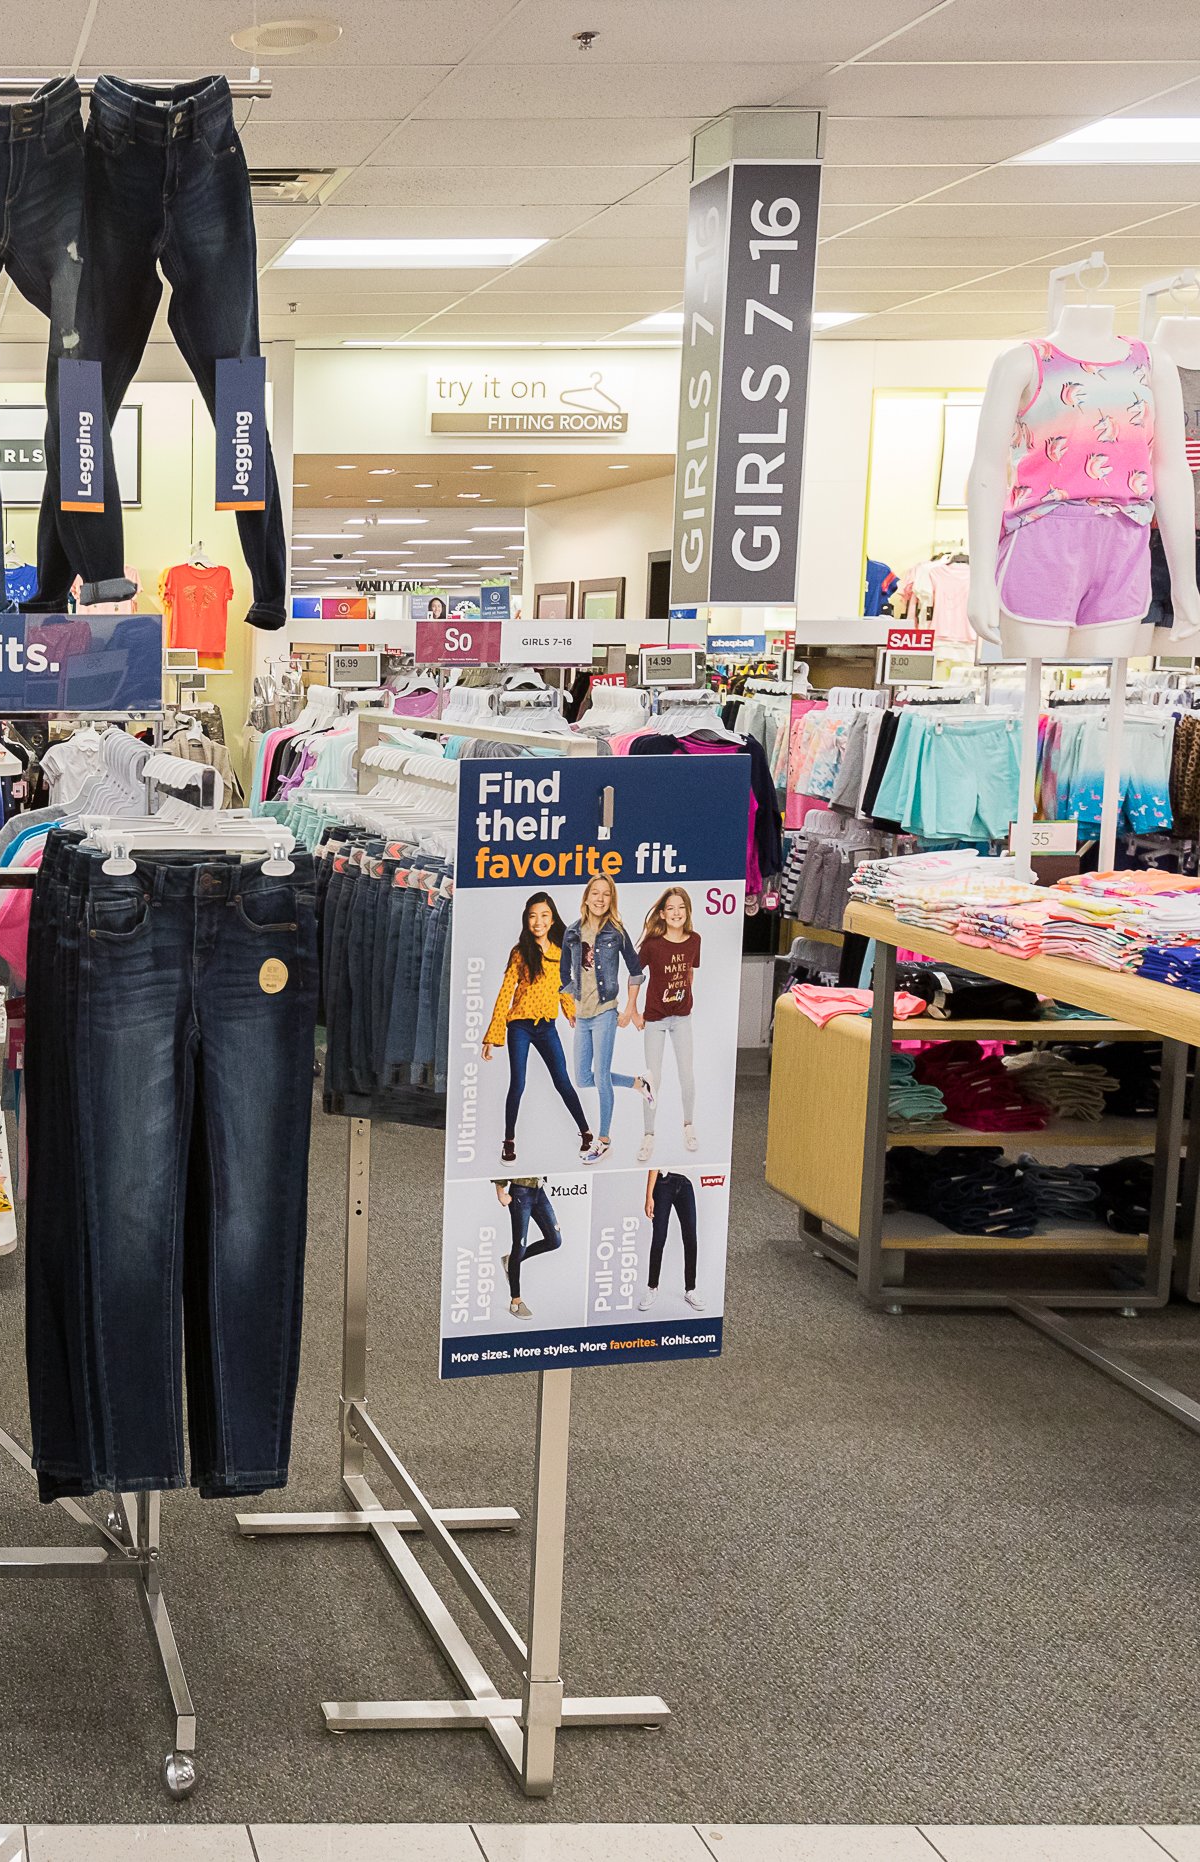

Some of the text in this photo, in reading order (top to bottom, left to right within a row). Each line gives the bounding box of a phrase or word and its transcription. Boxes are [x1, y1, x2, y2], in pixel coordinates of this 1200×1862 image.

[436, 374, 547, 406] try it on
[680, 206, 720, 574] GIRLS 7-16
[731, 197, 801, 572] GIRLS 7-16
[488, 414, 623, 431] FITTING ROOMS
[78, 411, 94, 496] Legging
[232, 411, 253, 496] Jegging
[355, 580, 397, 592] VANITY
[444, 627, 472, 652] So
[522, 638, 572, 646] GIRLS 7-16
[890, 633, 933, 648] SALE
[335, 659, 358, 668] 16.99
[648, 656, 672, 666] 14.99
[591, 676, 625, 687] SALE
[478, 770, 561, 805] Find
[475, 808, 566, 842] their
[1031, 832, 1049, 846] 35
[475, 842, 687, 879] favorite fit.
[705, 887, 737, 915] So
[671, 953, 685, 963] ART
[667, 980, 687, 990] WORL
[456, 956, 485, 1164] Ultimate Jegging
[550, 1184, 588, 1198] Mudd
[473, 1226, 497, 1321] Legging
[594, 1226, 616, 1312] Pull-On
[615, 1215, 640, 1311] Legging
[451, 1246, 475, 1324] Skinny
[451, 1333, 716, 1364] More sizes. More styles. More favorites. Kohls.com
